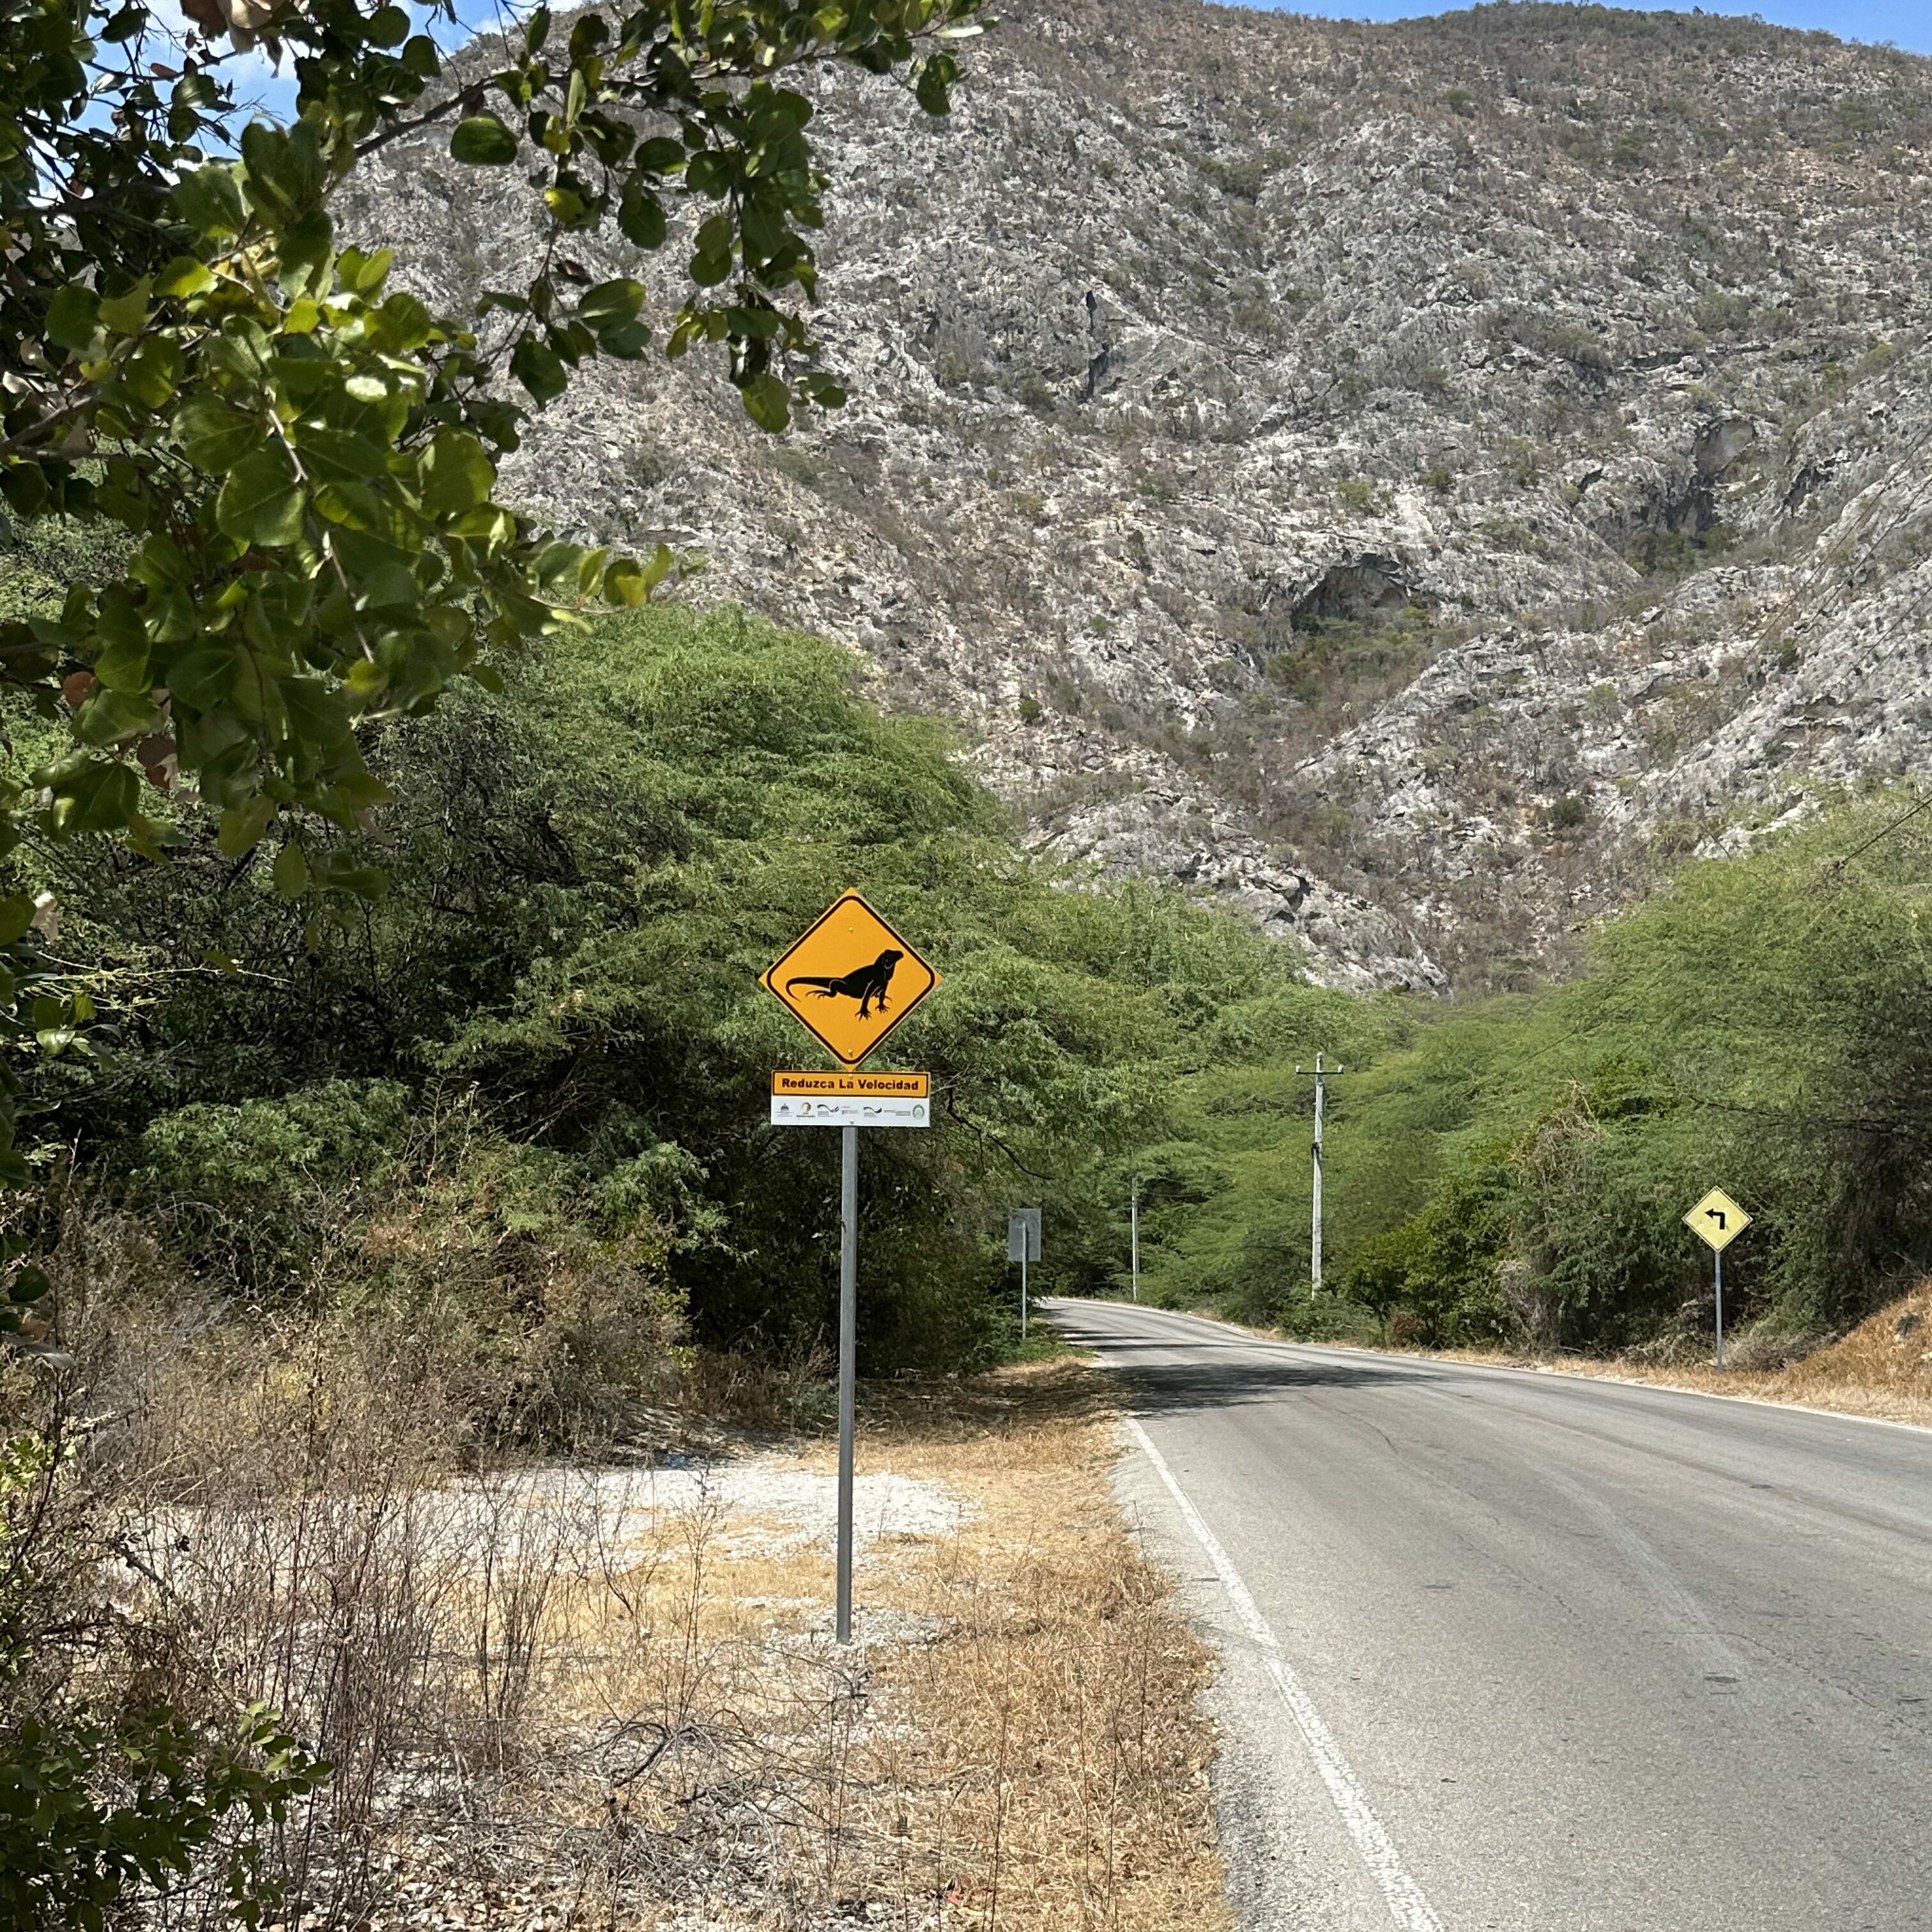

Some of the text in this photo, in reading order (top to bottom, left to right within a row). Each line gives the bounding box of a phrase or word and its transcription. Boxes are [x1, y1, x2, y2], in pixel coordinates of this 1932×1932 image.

[782, 1078, 919, 1090] Reduzca La Velocidad
